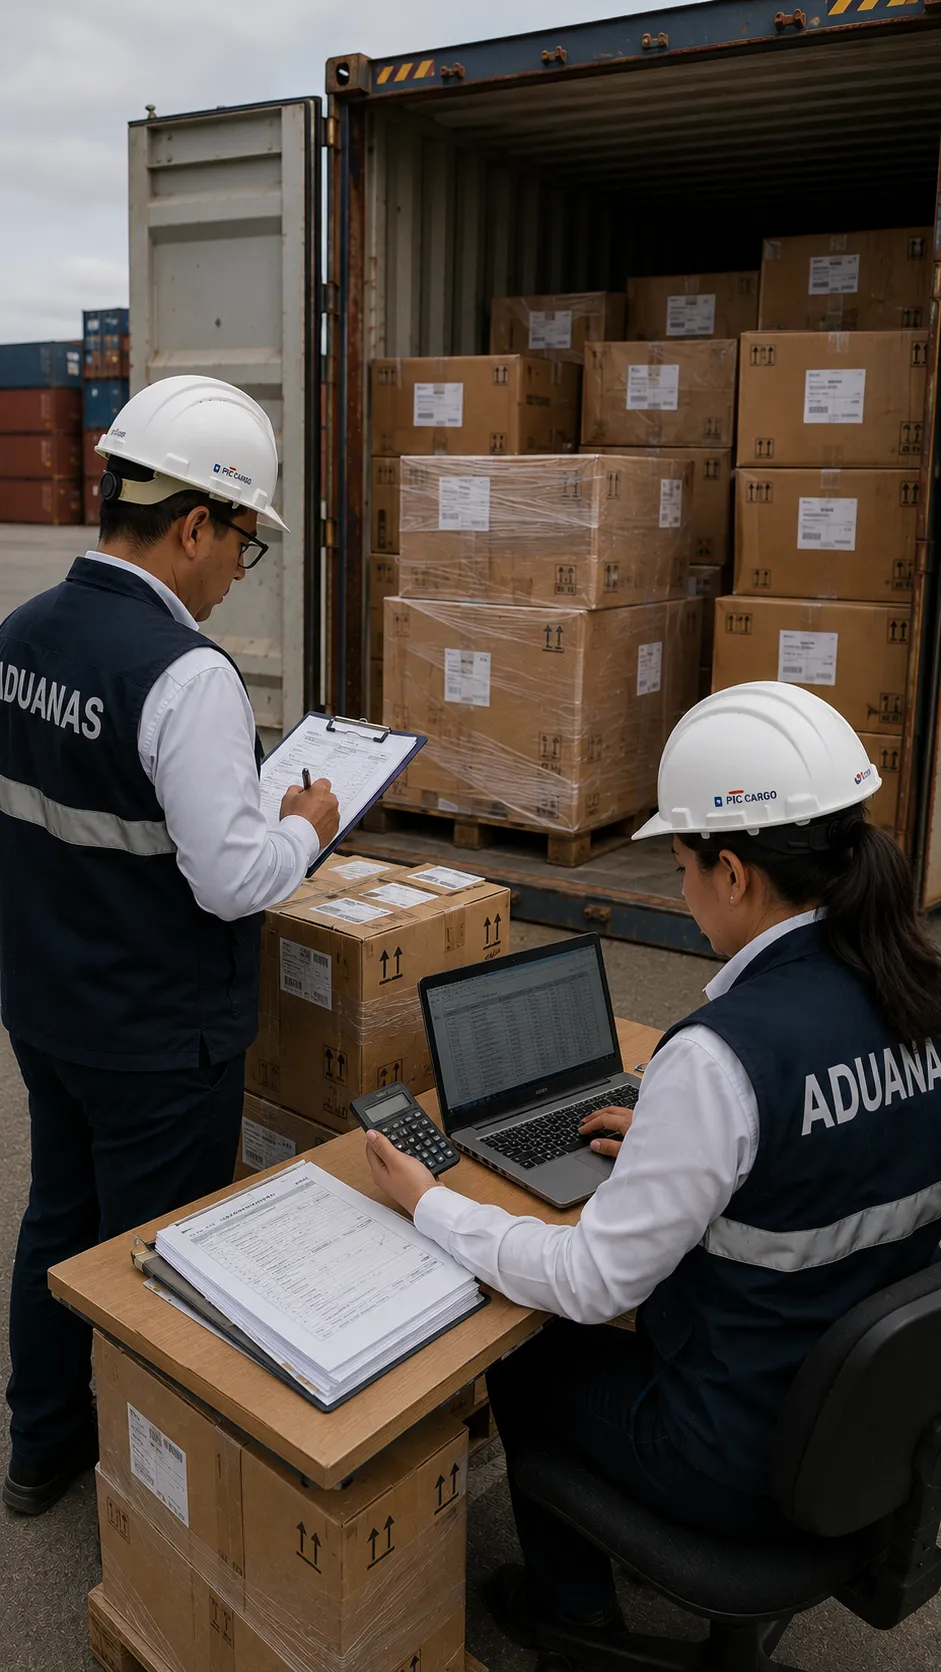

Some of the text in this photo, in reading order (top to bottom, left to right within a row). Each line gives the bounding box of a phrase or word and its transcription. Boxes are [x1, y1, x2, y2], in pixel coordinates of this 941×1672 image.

[726, 790, 777, 804] PIC CARGO
[801, 1036, 941, 1136] ADUANA
